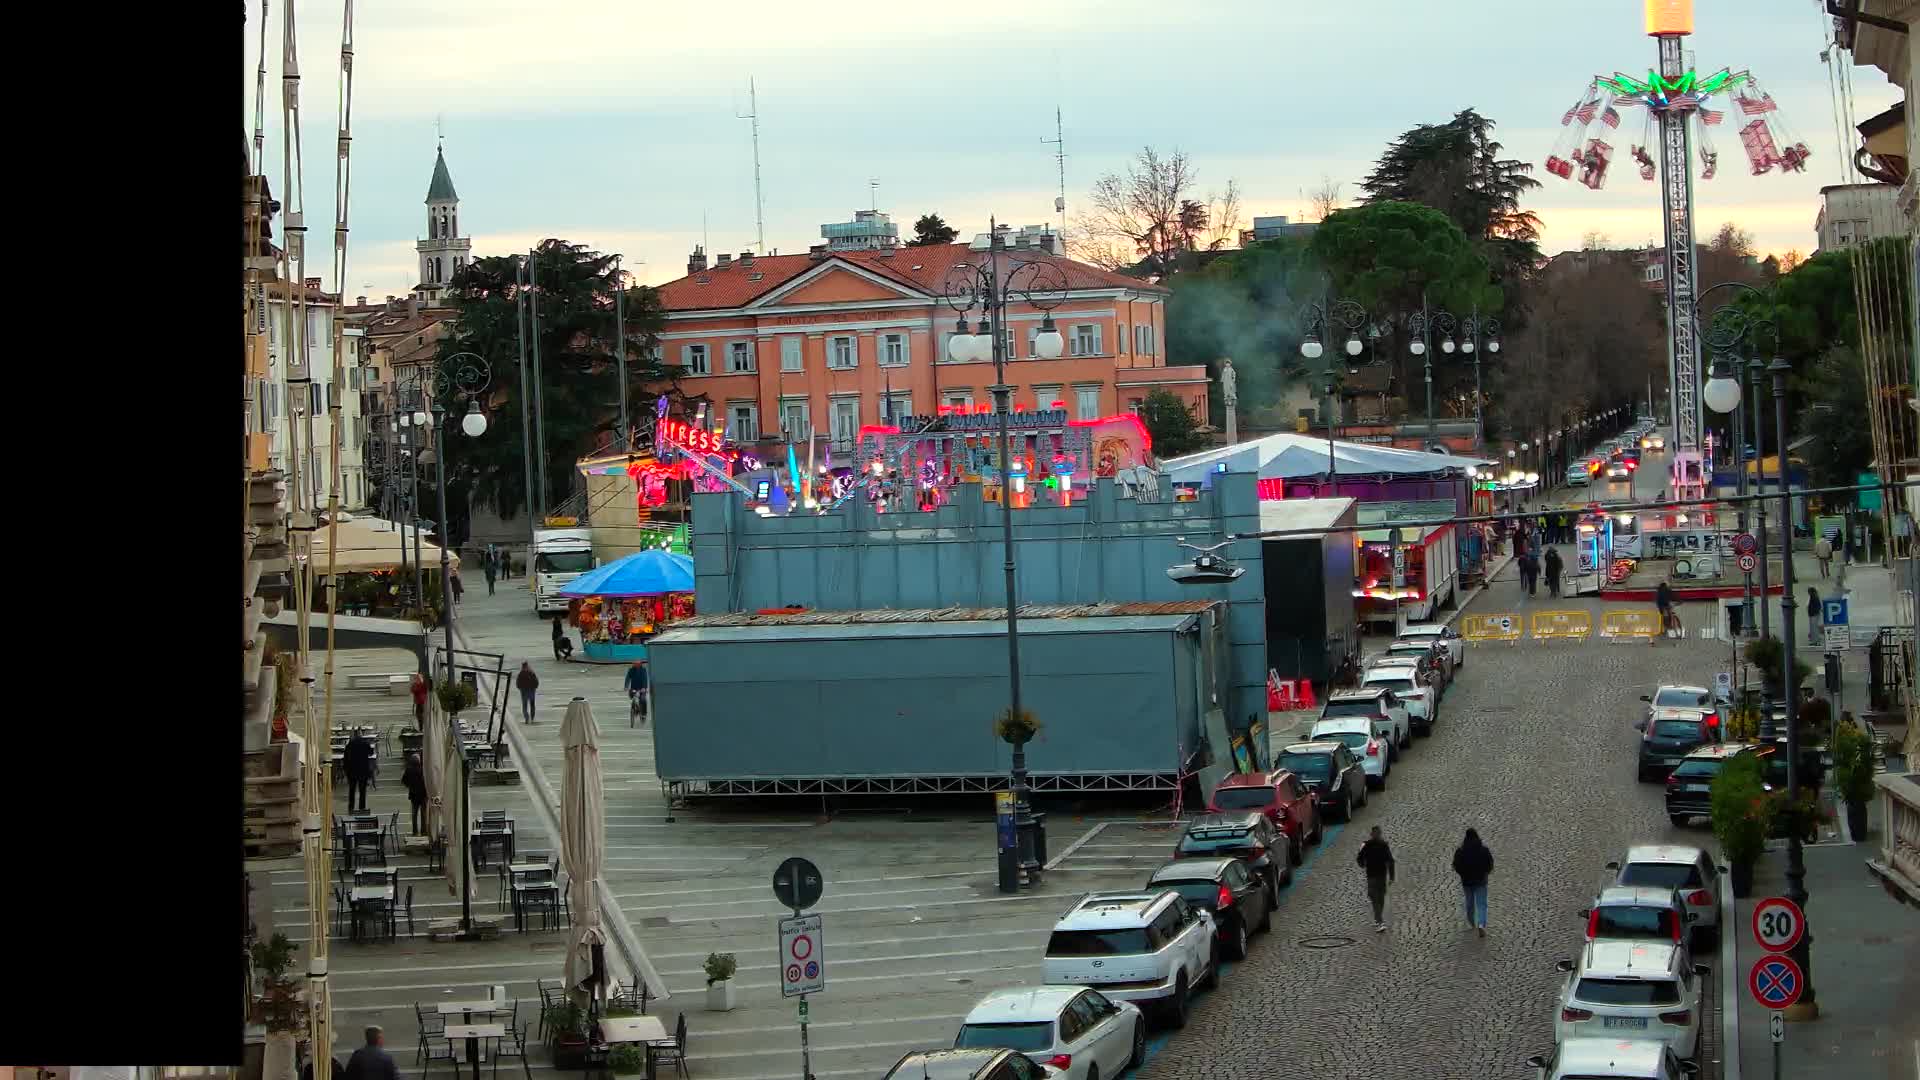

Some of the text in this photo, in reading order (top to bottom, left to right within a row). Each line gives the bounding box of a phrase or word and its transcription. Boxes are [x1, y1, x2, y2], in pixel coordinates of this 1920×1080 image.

[1742, 558, 1753, 567] 20
[1827, 602, 1842, 622] P
[1761, 912, 1791, 937] 30
